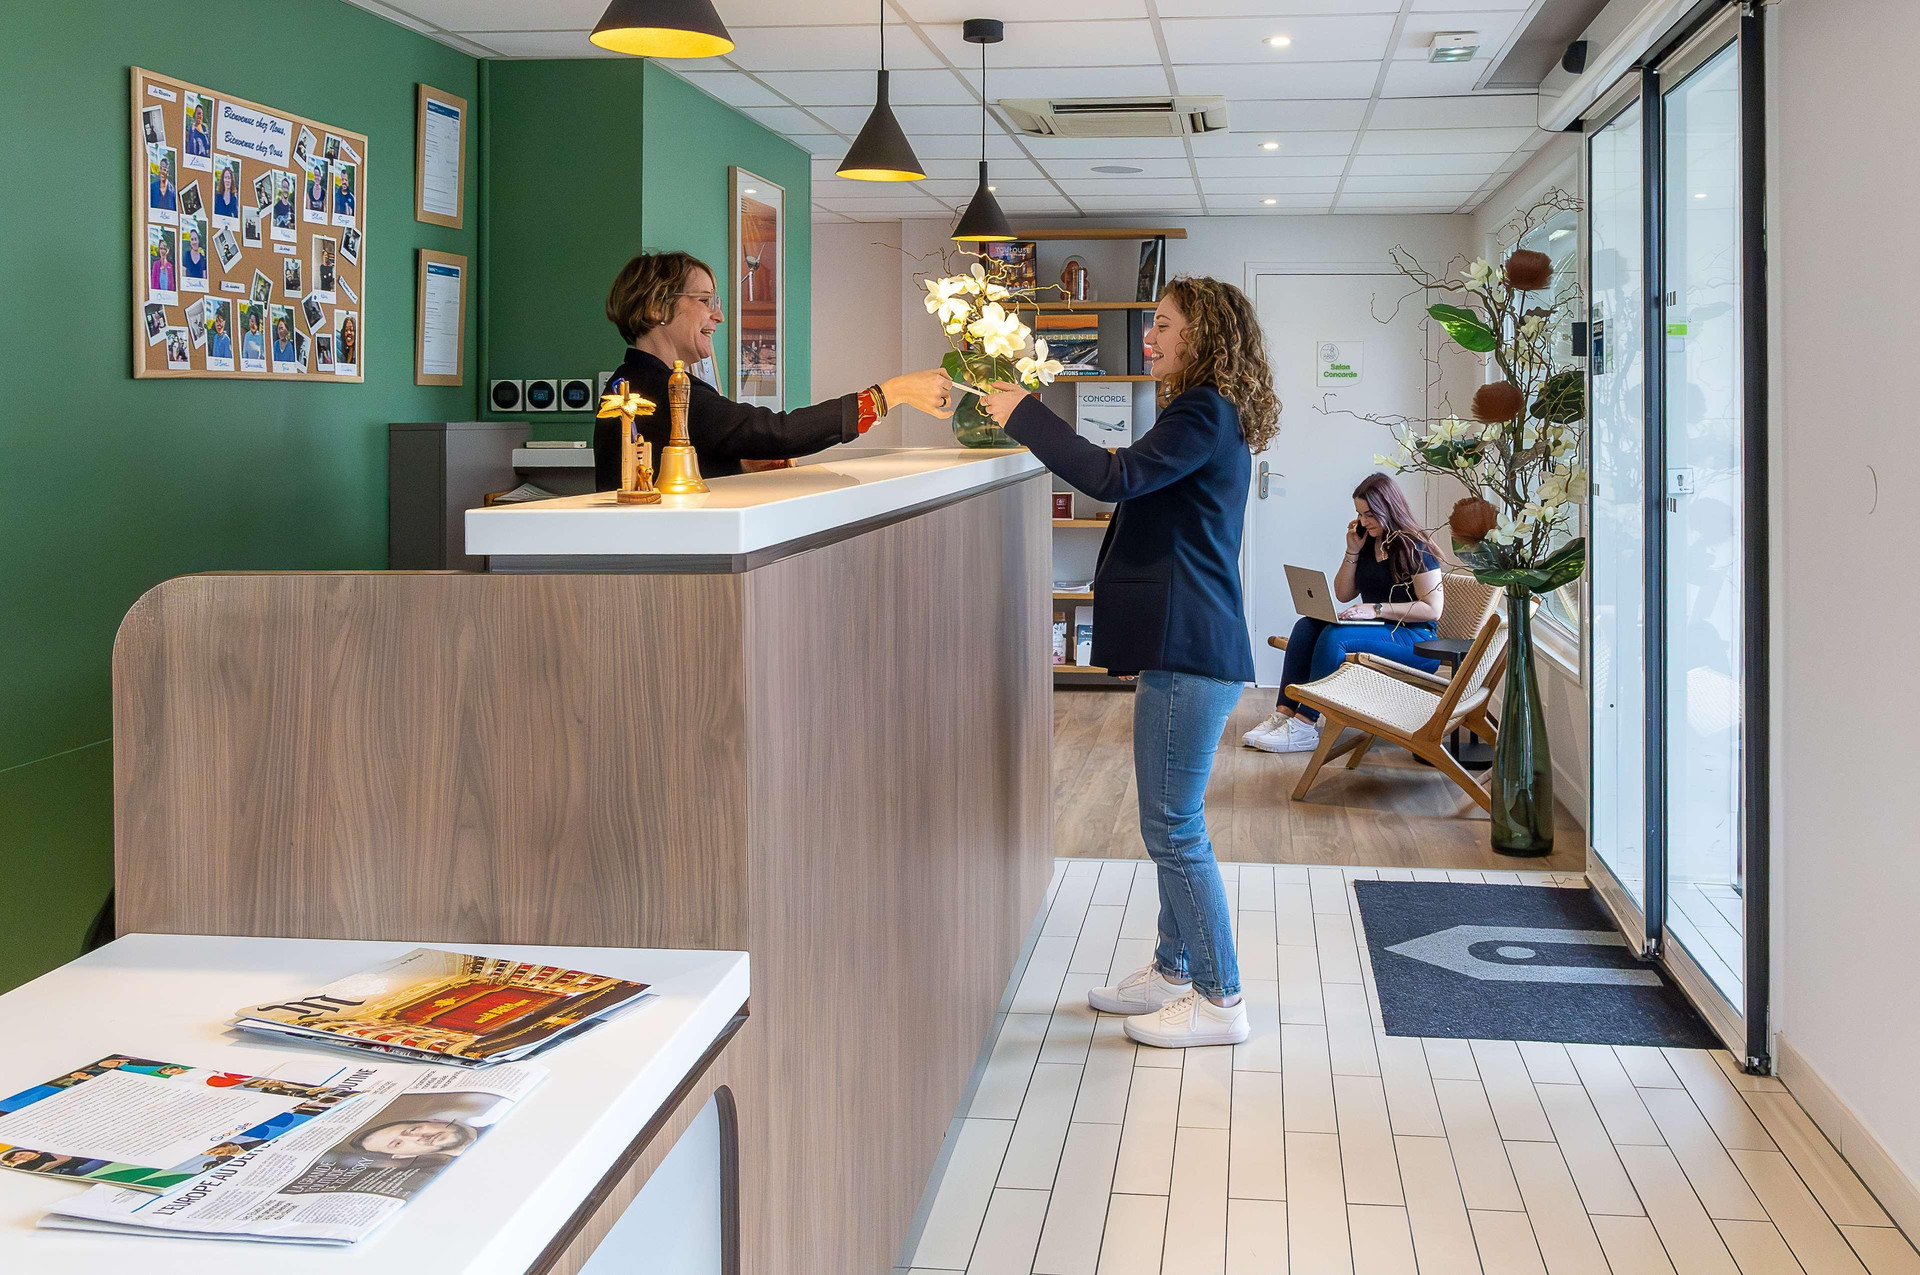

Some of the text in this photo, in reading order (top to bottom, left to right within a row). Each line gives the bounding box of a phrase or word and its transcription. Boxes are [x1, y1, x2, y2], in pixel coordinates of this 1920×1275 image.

[223, 106, 255, 126] Bienvenue
[255, 117, 268, 133] chez
[224, 130, 283, 158] Bienvenue chez Vous
[1082, 395, 1127, 403] CONCORDE
[210, 1122, 253, 1142] Google
[152, 1179, 222, 1216] L'EUROPE
[210, 1166, 239, 1183] AU
